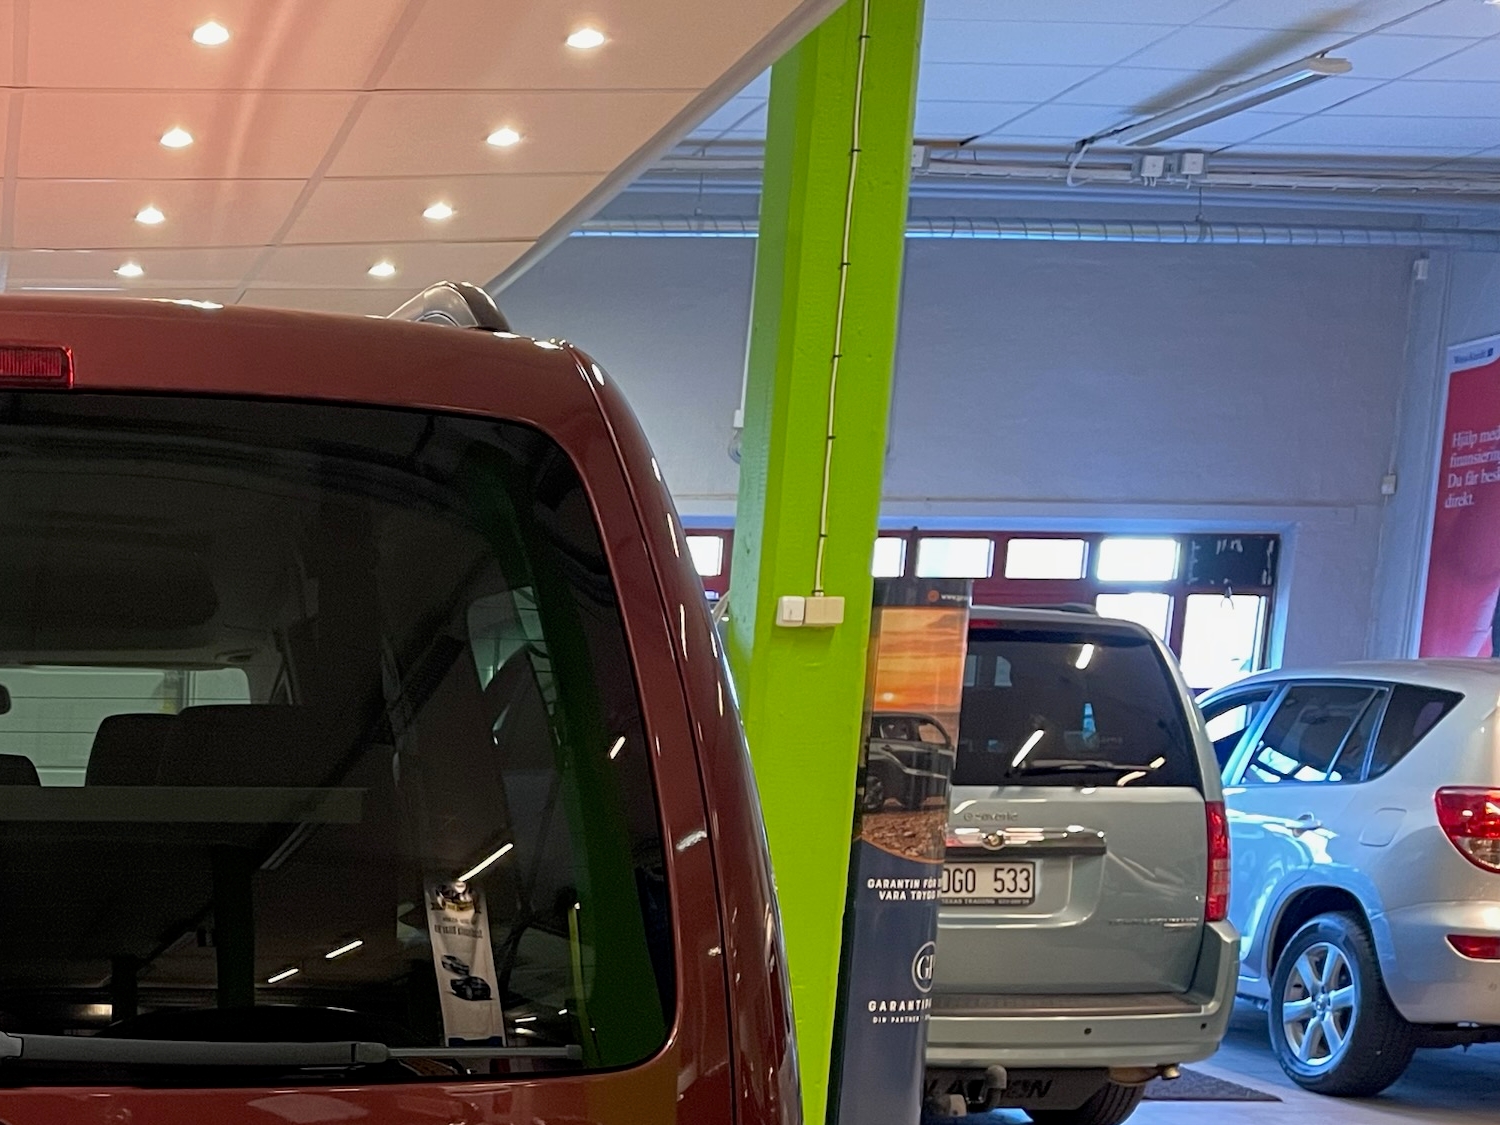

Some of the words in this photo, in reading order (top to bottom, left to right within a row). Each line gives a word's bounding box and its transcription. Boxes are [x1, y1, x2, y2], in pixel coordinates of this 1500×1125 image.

[867, 878, 920, 889] GARANTIN
[993, 867, 1031, 893] 533
[879, 890, 907, 901] VARA
